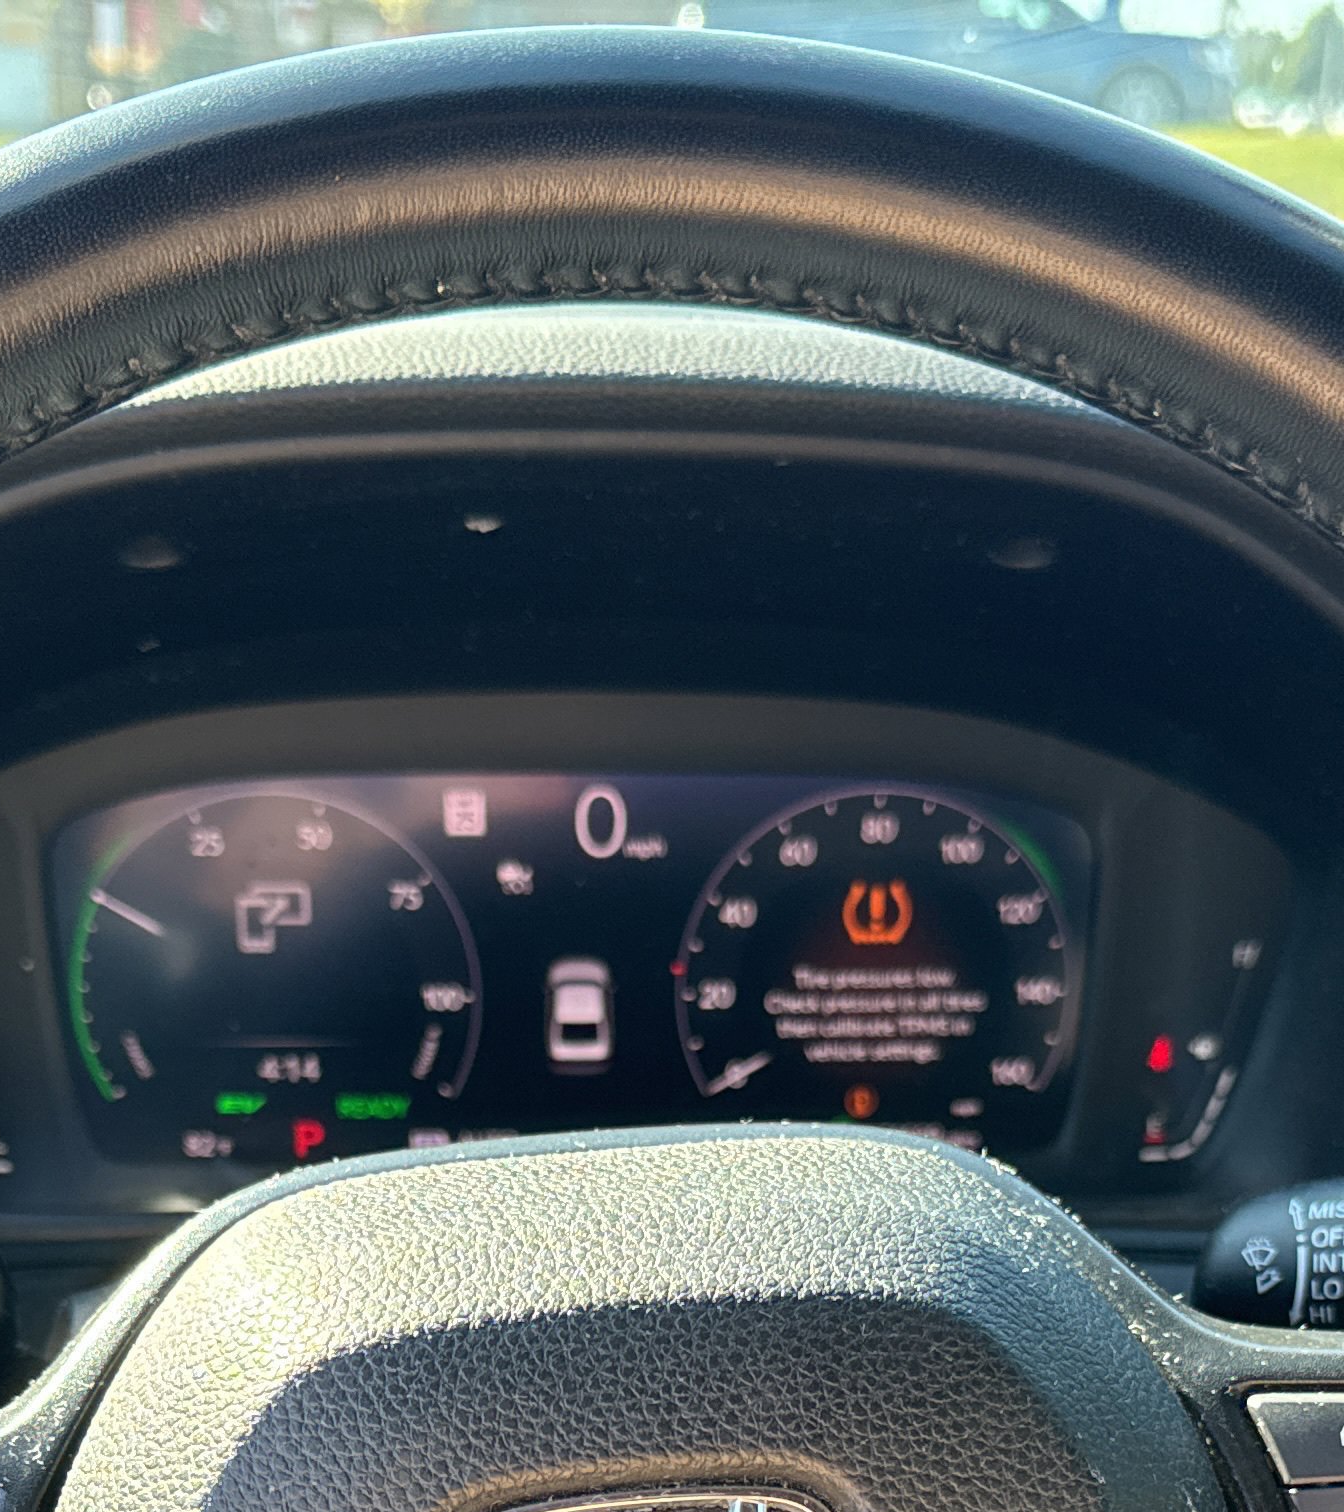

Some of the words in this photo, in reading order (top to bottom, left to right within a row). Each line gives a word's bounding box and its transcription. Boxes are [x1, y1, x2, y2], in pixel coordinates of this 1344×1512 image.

[575, 783, 627, 859] 0
[860, 809, 899, 844] 80
[940, 833, 985, 864] 100
[386, 879, 423, 911] 75
[421, 982, 464, 1012] 100
[698, 978, 736, 1010] 20
[292, 1118, 326, 1160] P
[1309, 1304, 1337, 1325] HI
